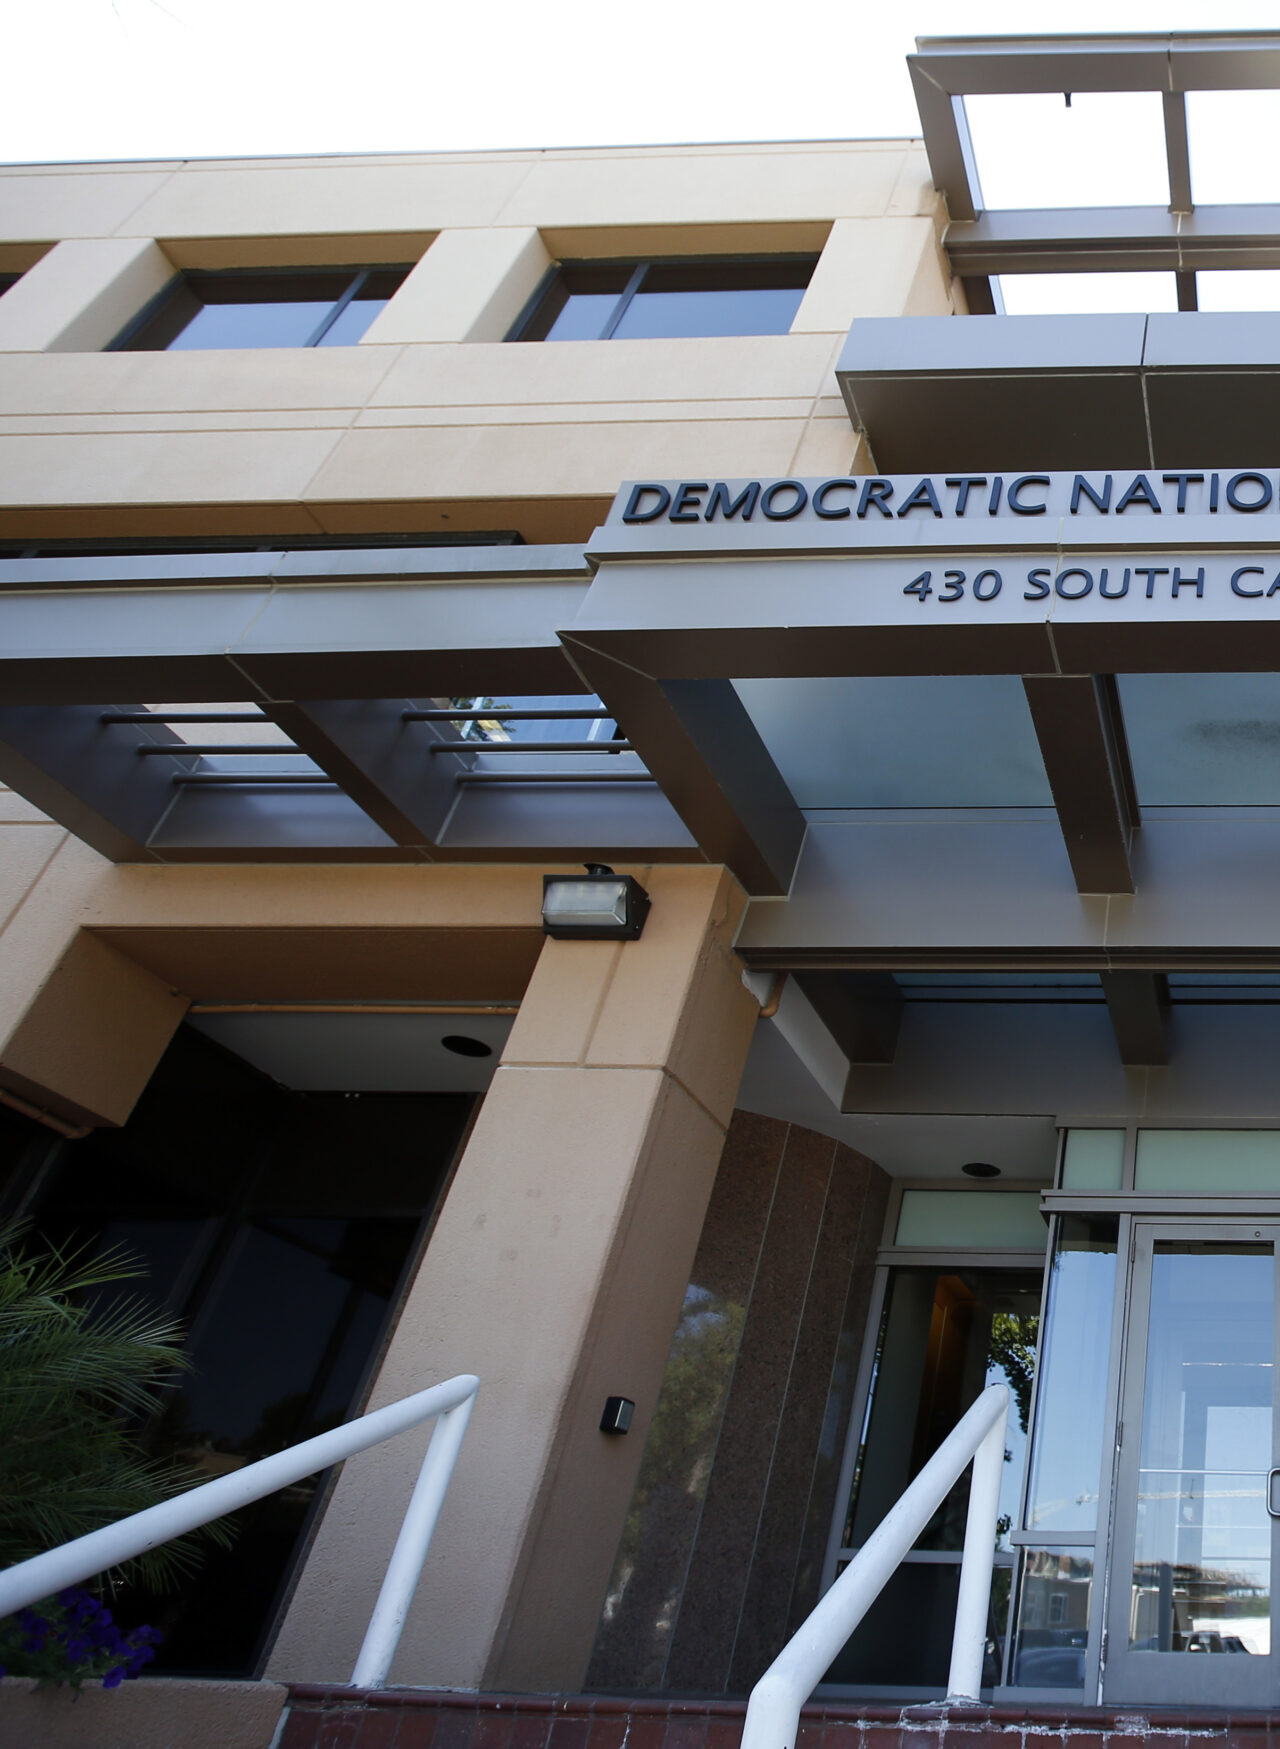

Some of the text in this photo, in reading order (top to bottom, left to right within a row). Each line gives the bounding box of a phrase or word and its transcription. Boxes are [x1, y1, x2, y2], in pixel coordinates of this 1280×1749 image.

[621, 476, 1051, 524] DEMOCRATIC
[902, 569, 1003, 603] 430
[1022, 567, 1206, 601] SOUTH
